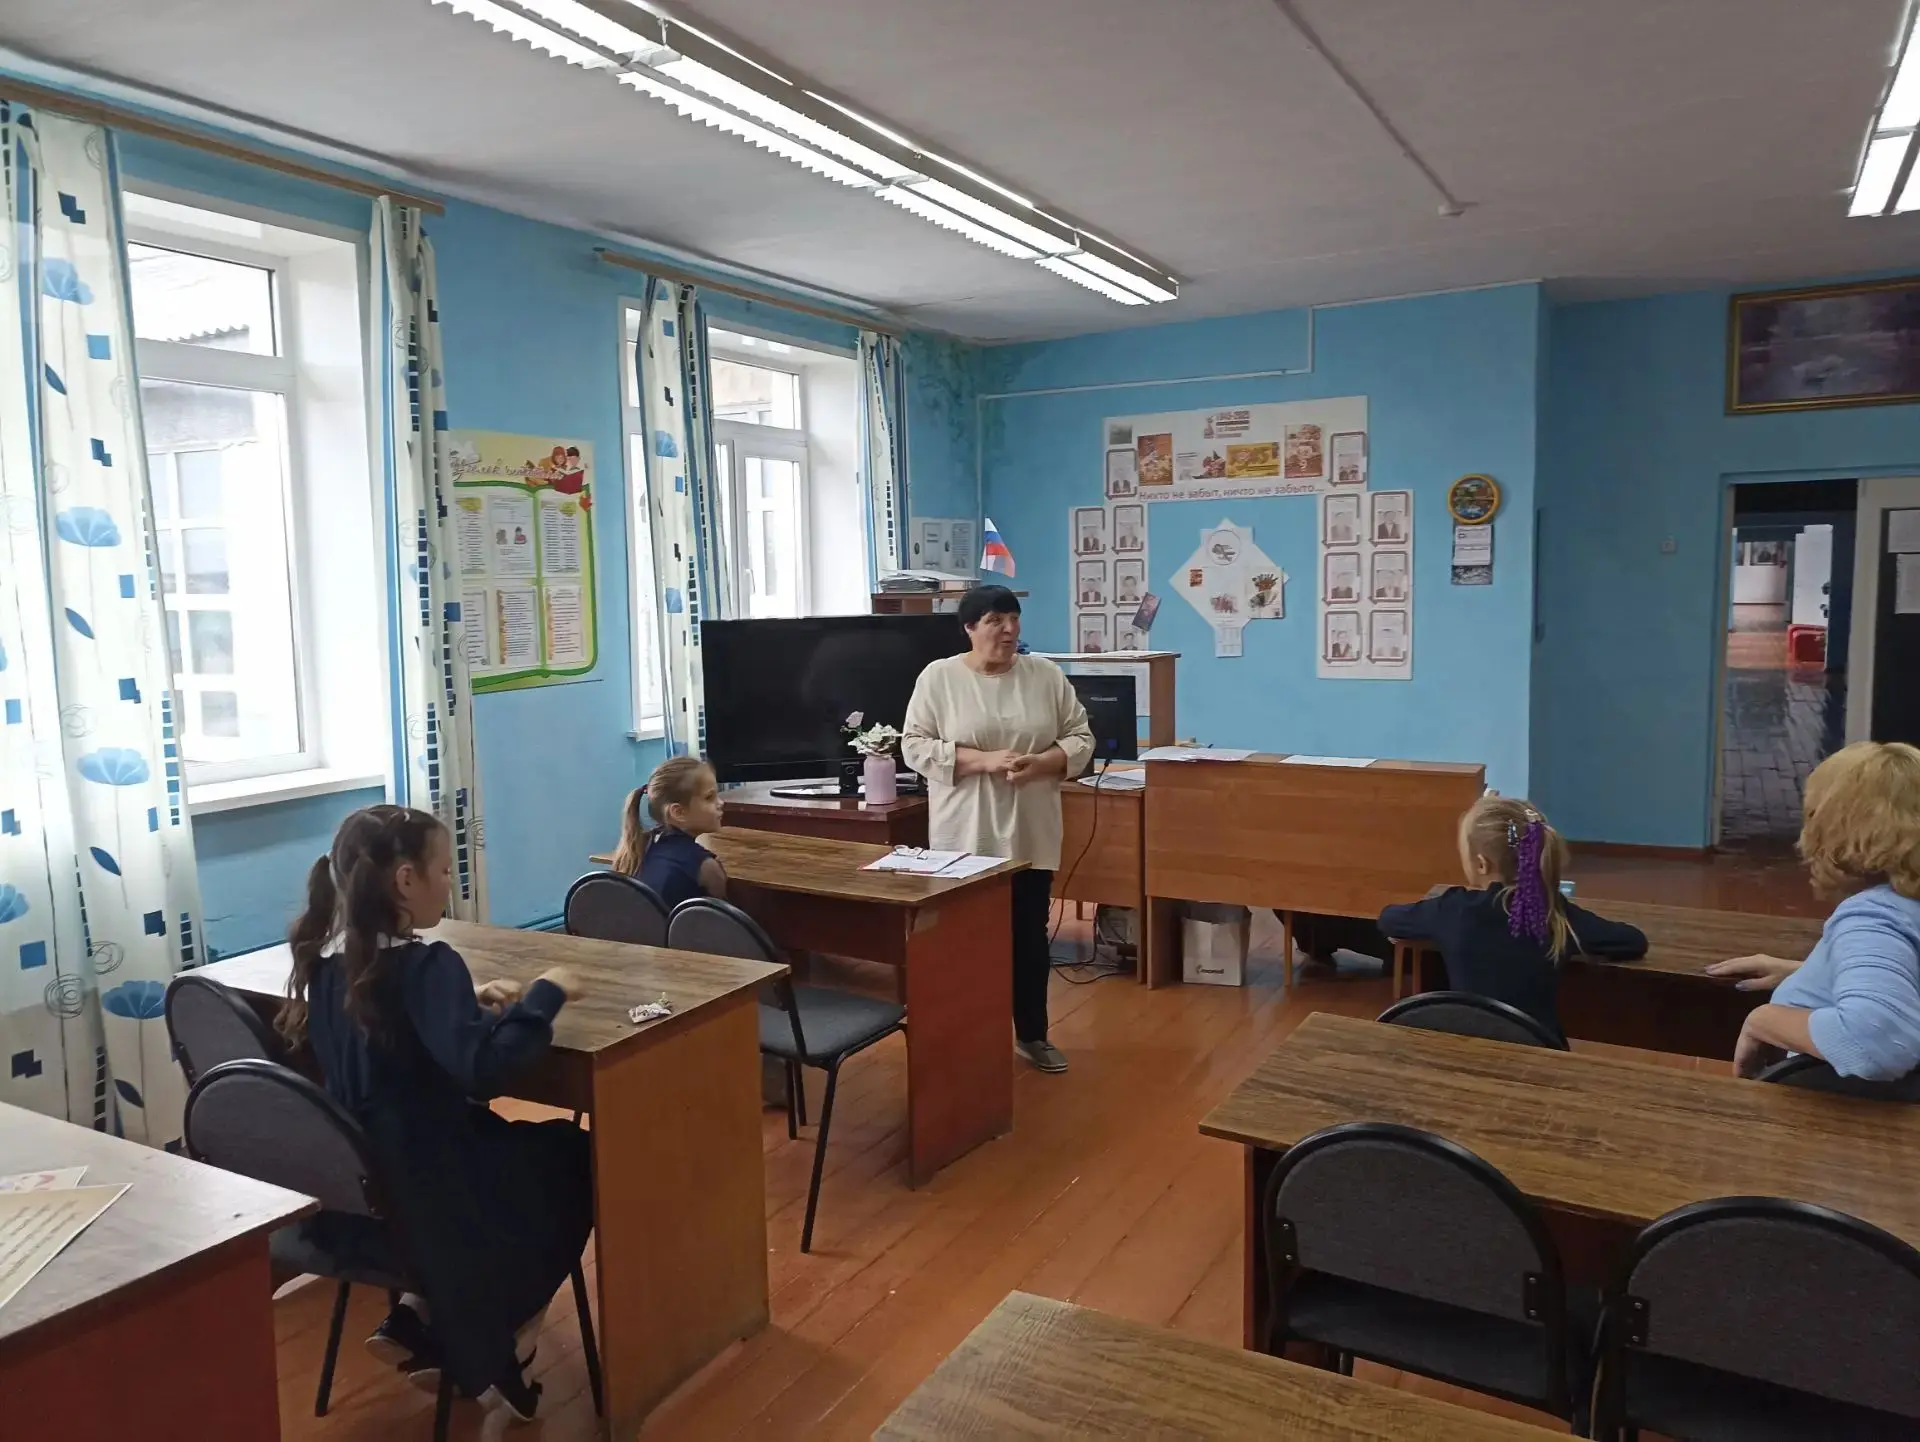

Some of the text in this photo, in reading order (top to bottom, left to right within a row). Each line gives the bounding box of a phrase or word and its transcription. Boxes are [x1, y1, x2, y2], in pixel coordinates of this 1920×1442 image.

[1139, 490, 1169, 500] Никто
[1173, 490, 1185, 499] не
[1223, 487, 1254, 496] ничто
[1258, 487, 1271, 495] не
